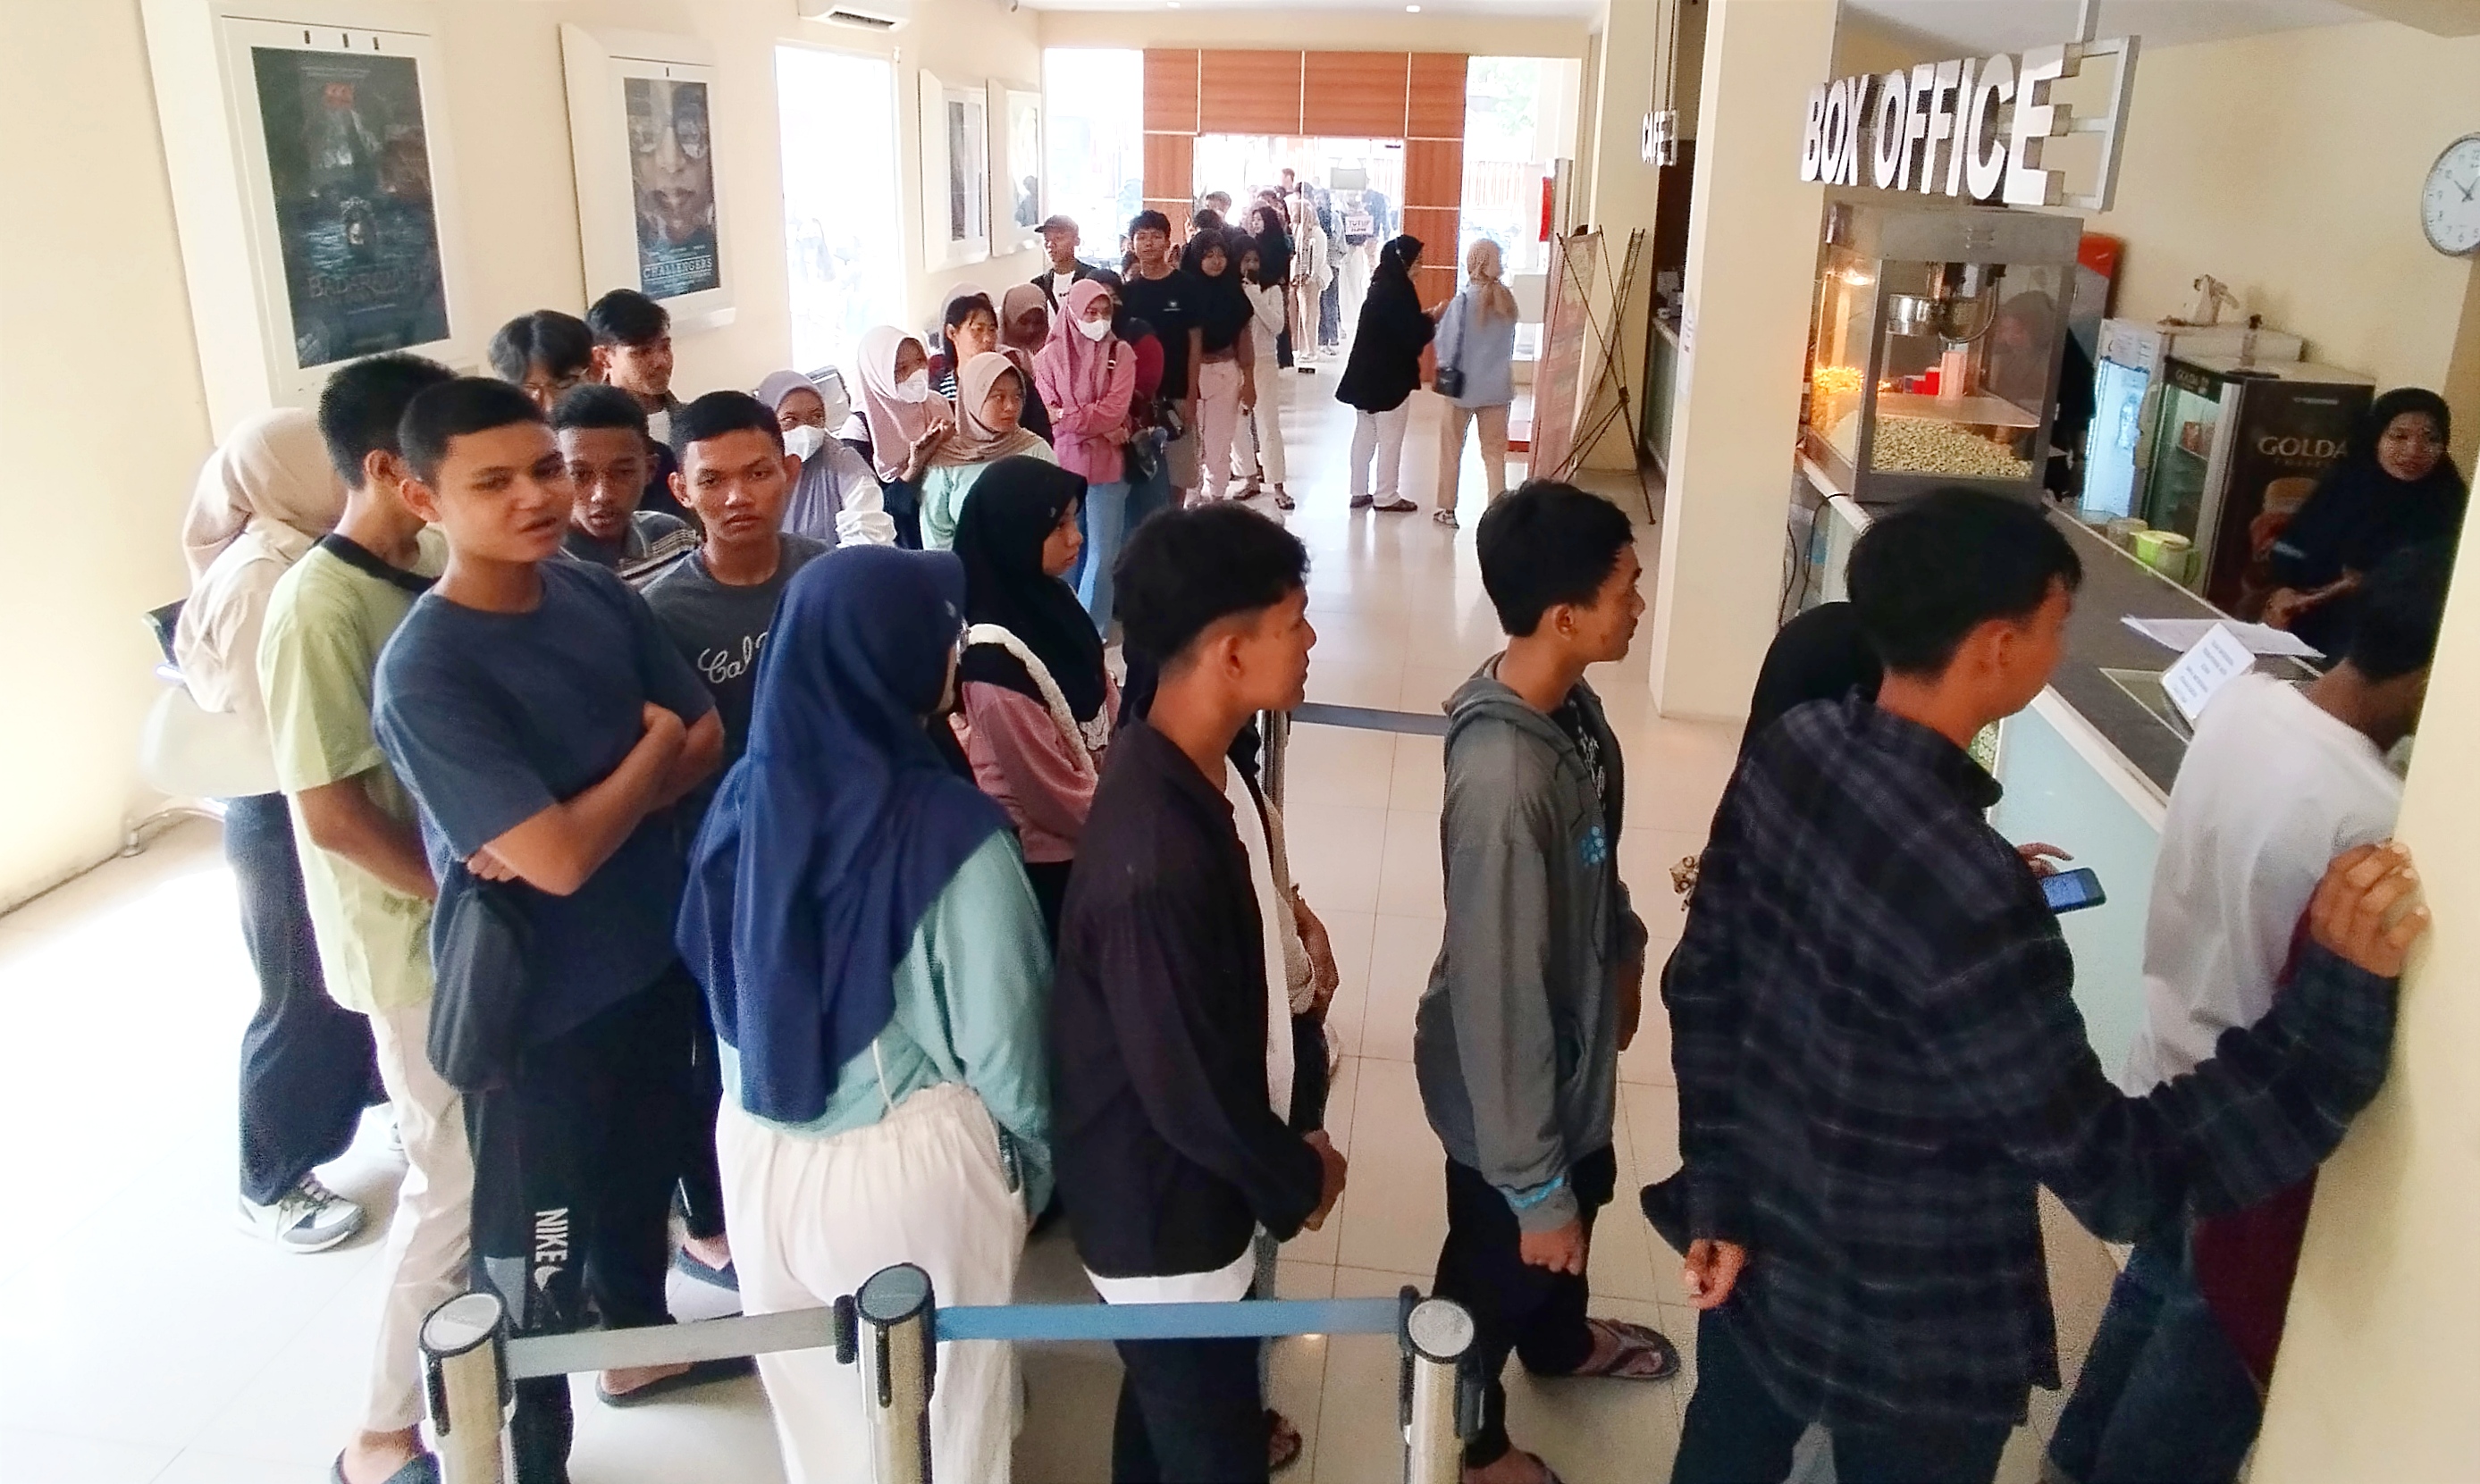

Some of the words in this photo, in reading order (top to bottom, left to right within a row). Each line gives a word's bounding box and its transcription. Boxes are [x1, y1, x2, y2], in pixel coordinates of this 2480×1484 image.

[1800, 73, 1870, 186] BOX
[1874, 43, 2066, 205] OFFICE
[643, 257, 713, 280] CHALLENGERS
[2257, 435, 2350, 459] GOLDA
[534, 1207, 569, 1263] NIKE
